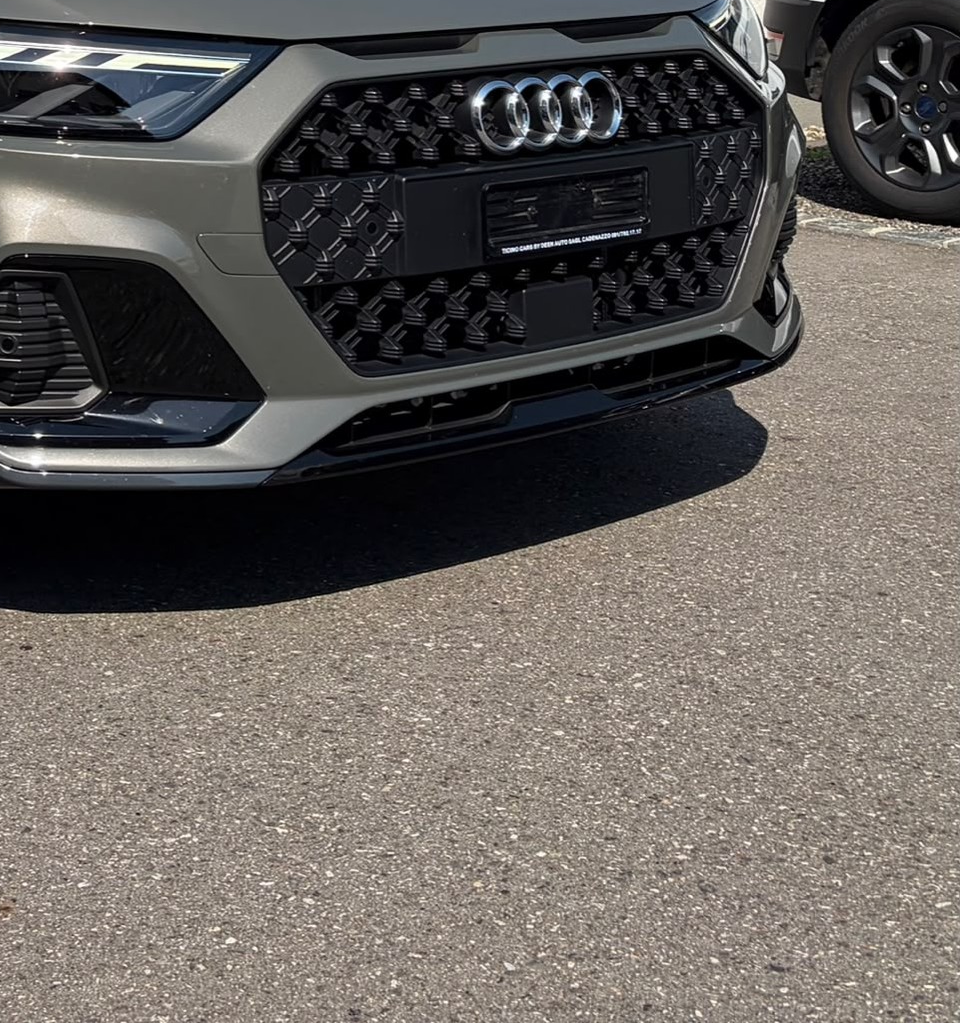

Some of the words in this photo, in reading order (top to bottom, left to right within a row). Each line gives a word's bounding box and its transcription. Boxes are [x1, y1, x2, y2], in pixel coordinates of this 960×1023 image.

[502, 246, 519, 254] TICINO
[519, 244, 533, 252] CARS
[554, 239, 568, 247] AUTO
[582, 233, 610, 242] CADENAZZO
